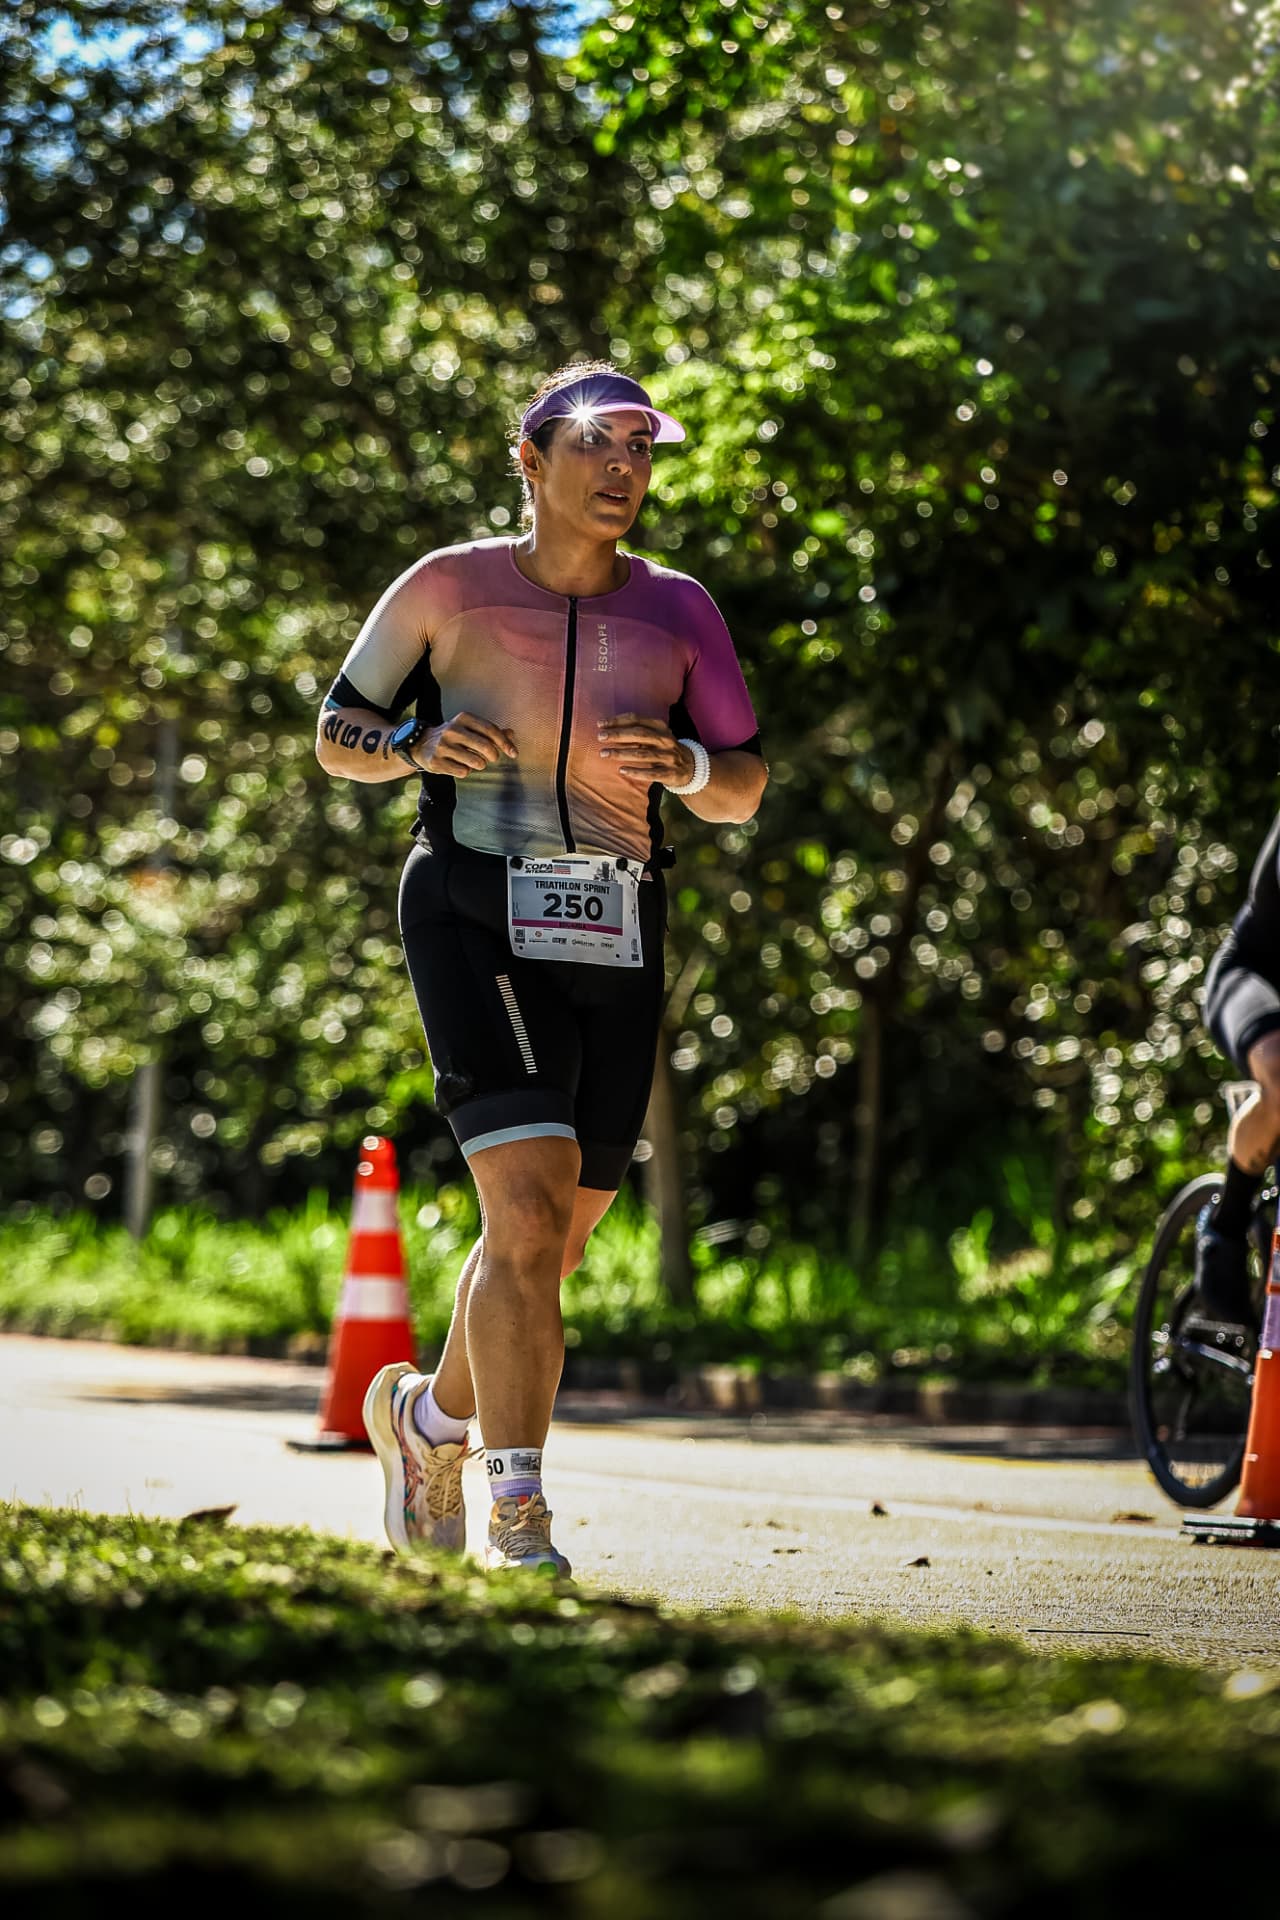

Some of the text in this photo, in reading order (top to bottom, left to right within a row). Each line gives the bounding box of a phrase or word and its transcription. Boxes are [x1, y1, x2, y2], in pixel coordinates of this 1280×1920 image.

[597, 623, 608, 672] ESCAPE
[324, 714, 382, 754] 250
[534, 880, 611, 895] TRIATHLON SPRINT
[542, 892, 604, 922] 250
